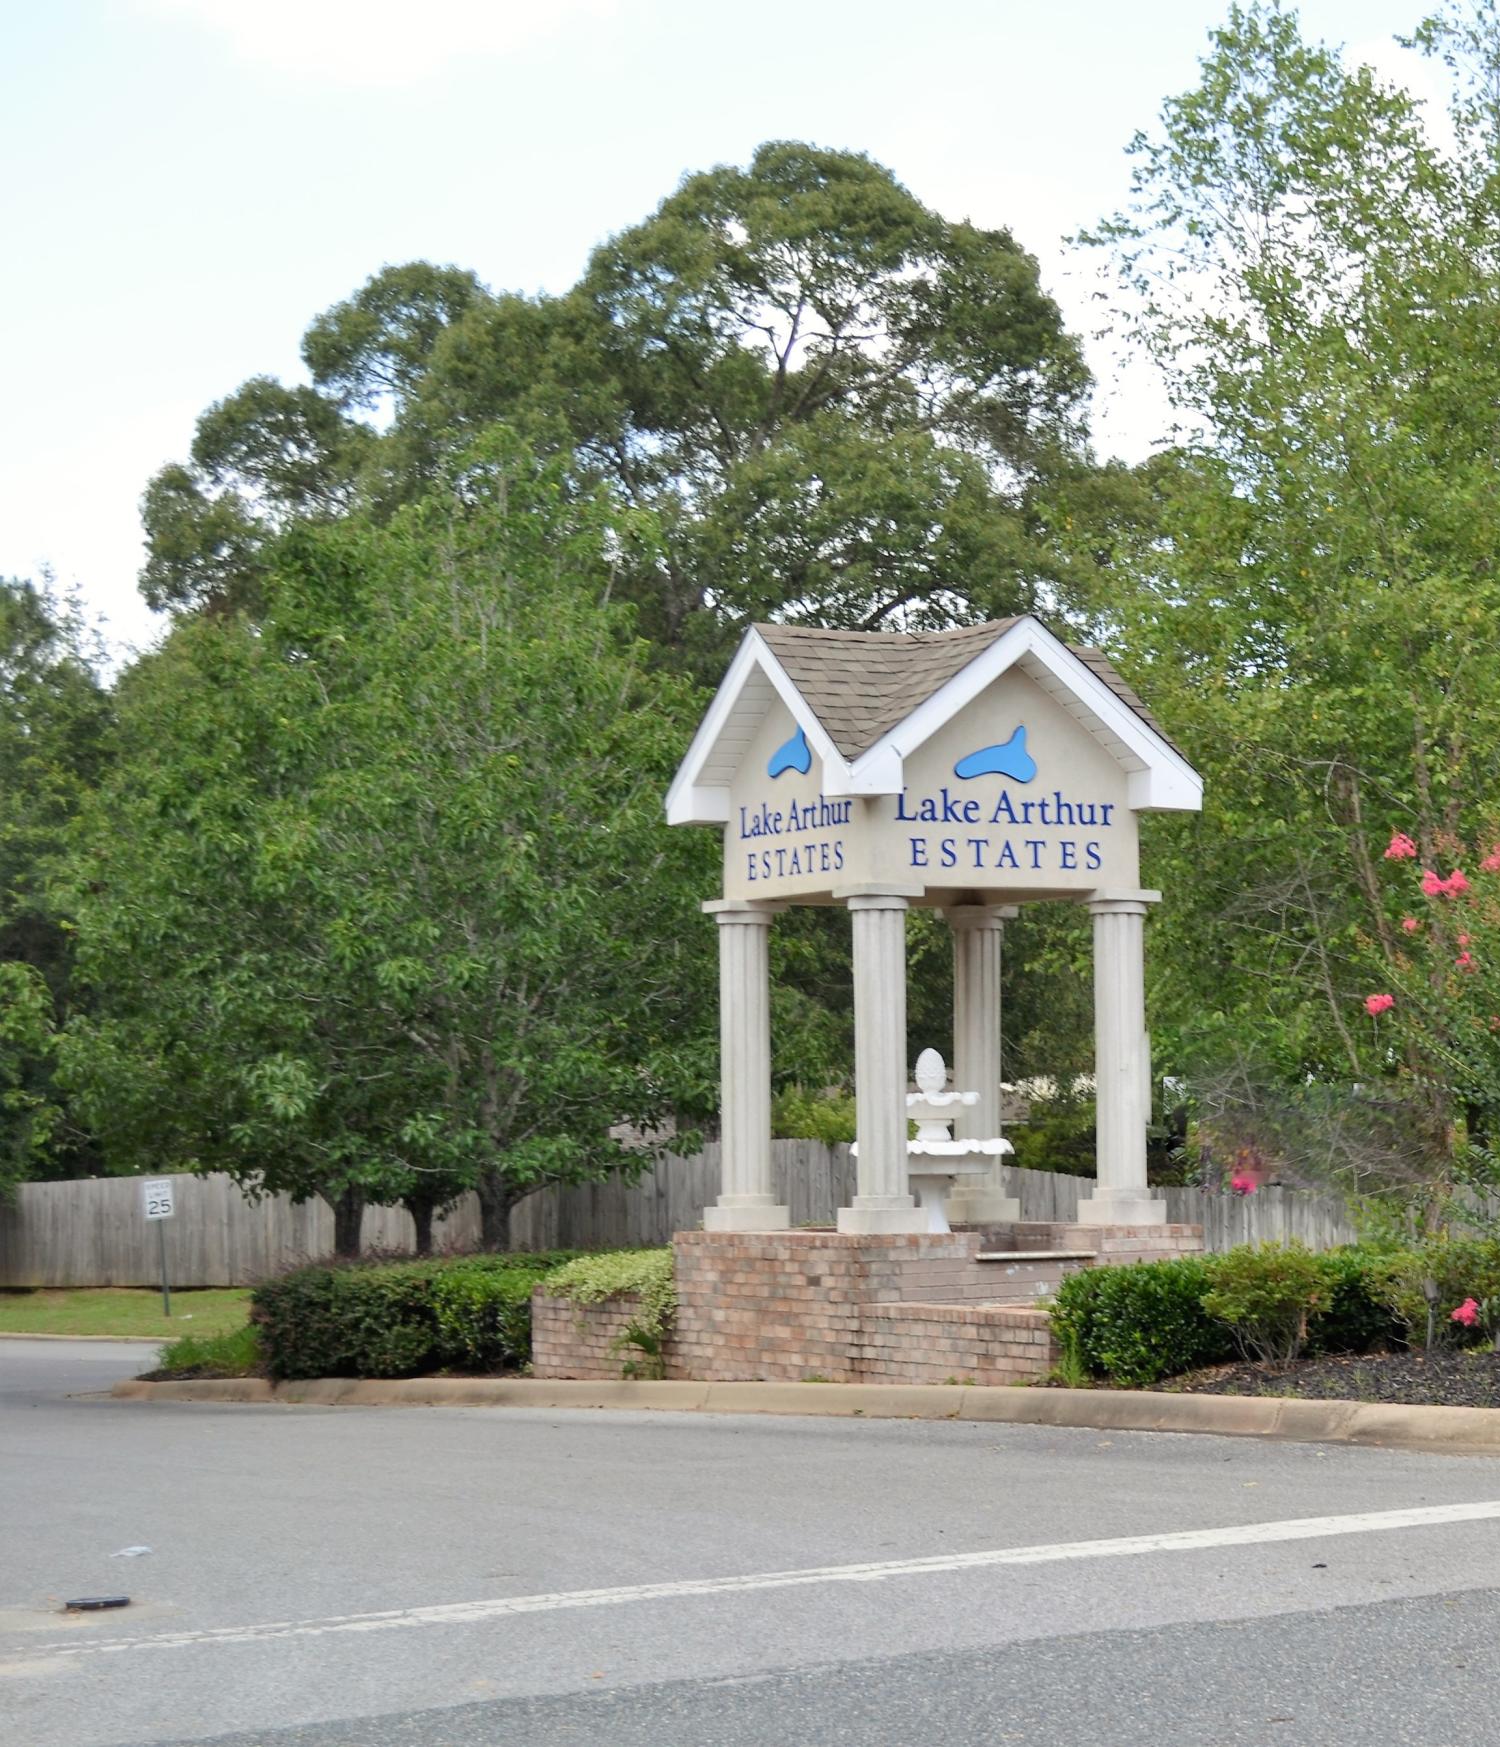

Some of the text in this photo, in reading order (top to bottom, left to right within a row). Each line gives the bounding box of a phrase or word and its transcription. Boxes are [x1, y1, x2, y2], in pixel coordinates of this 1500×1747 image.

[739, 794, 853, 839] Lake Arthur
[894, 787, 1115, 826] Lake Arthur
[747, 841, 844, 881] ESTATES
[909, 838, 1103, 870] ESTATES
[148, 1199, 171, 1215] 25
